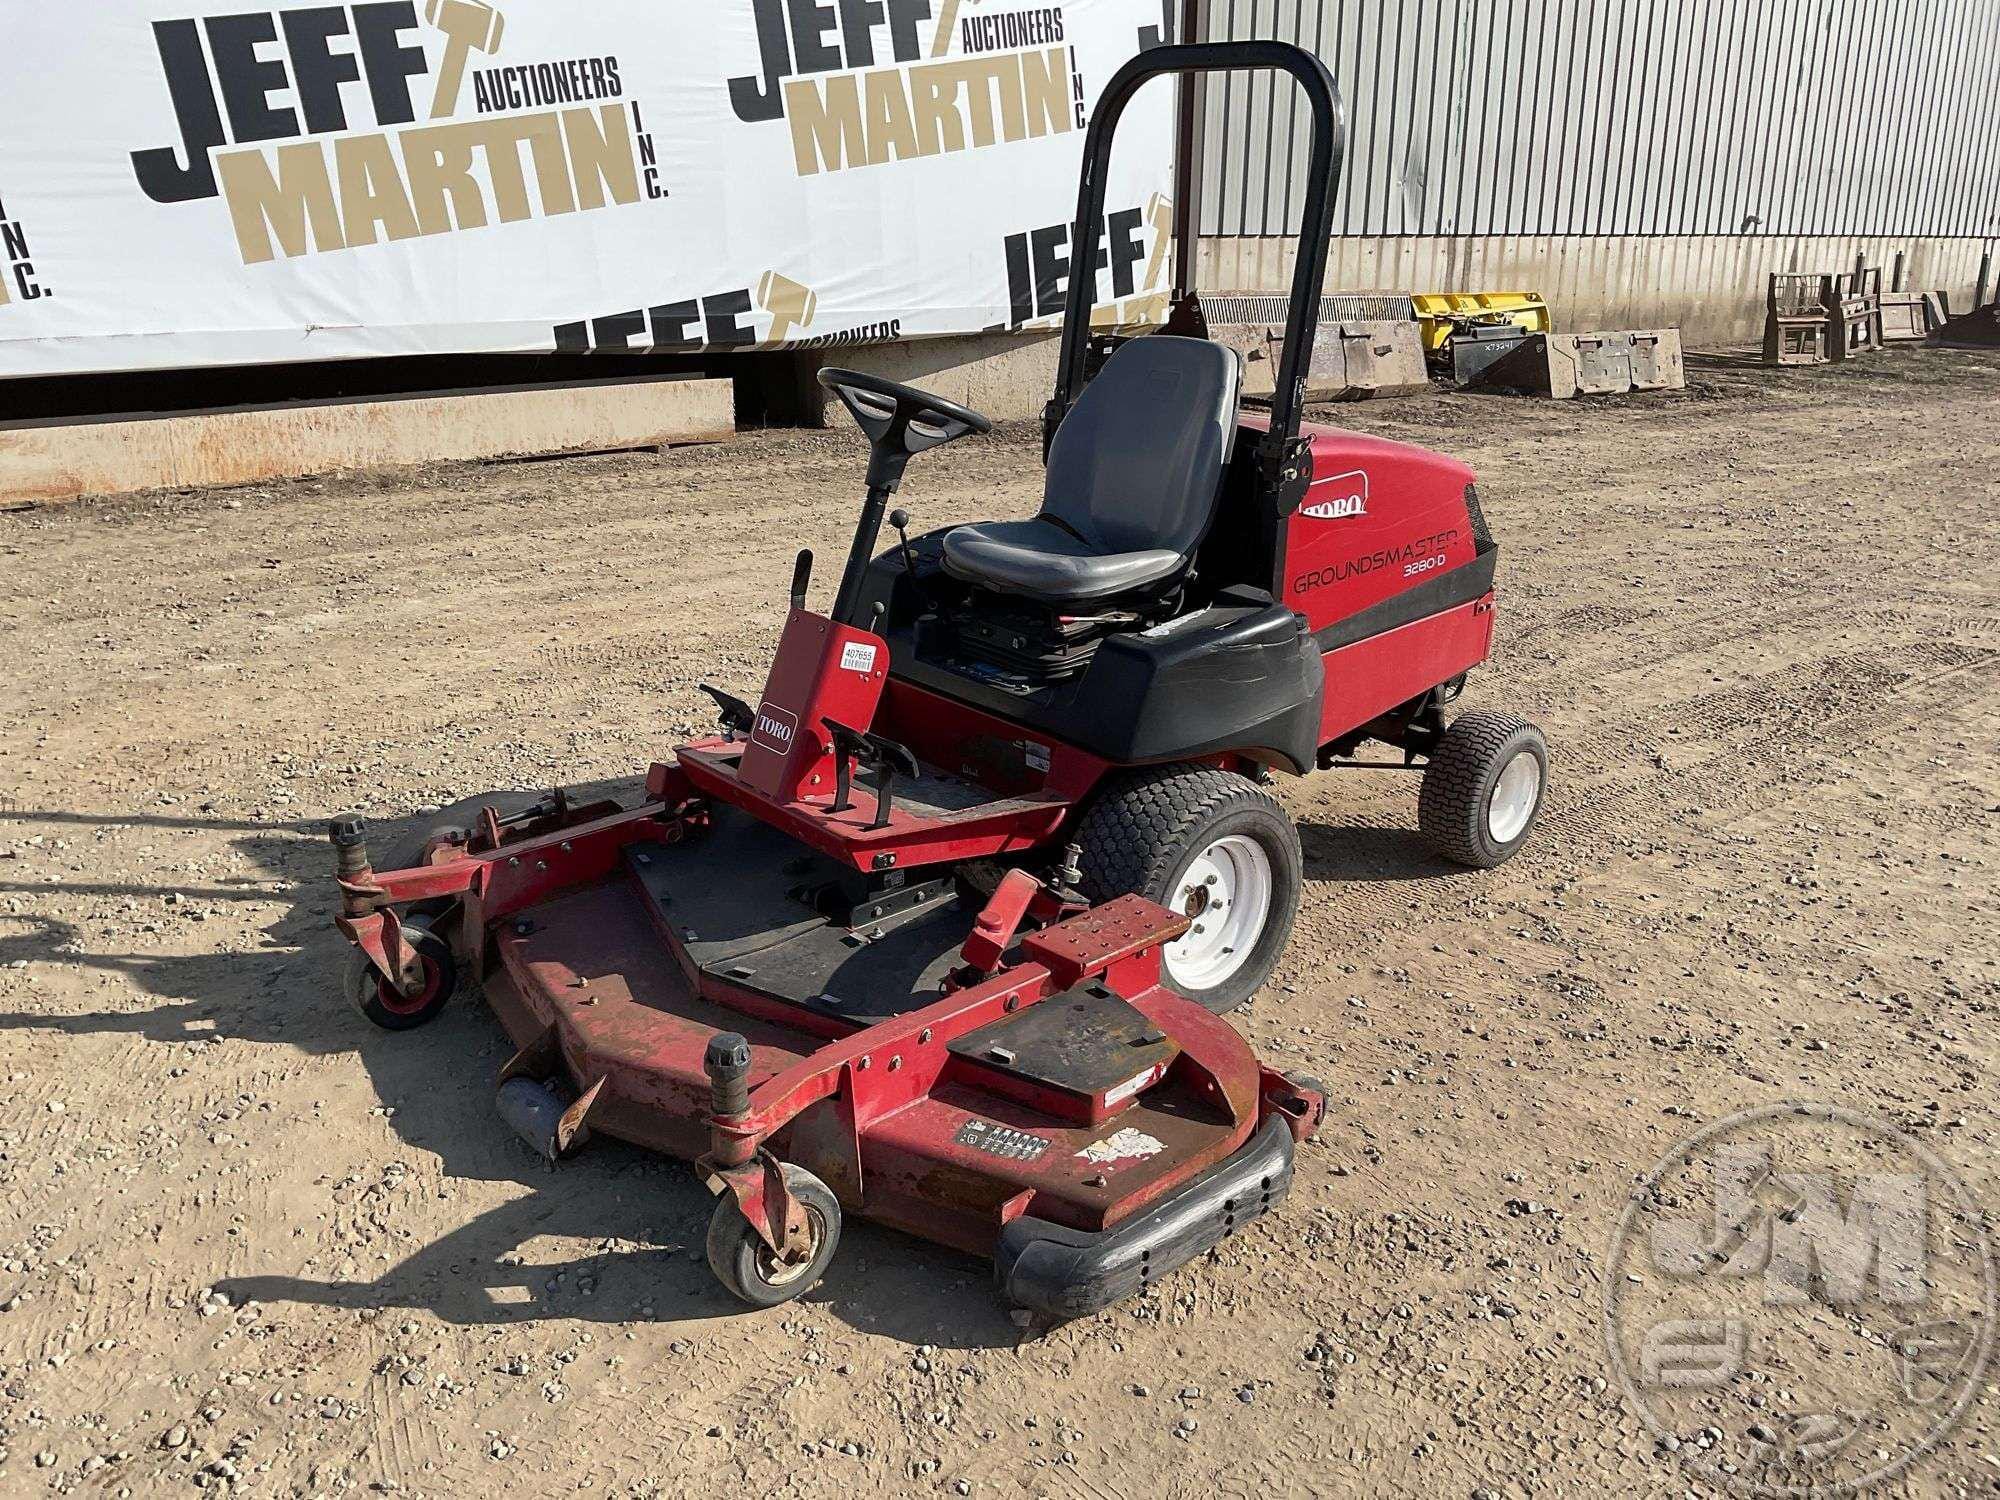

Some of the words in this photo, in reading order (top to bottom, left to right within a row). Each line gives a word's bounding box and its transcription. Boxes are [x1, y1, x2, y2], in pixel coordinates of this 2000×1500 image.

[962, 8, 1064, 54] AUCTIONEERS
[130, 0, 428, 203] JEFF
[473, 56, 622, 113] AUCTIONEERS
[784, 47, 1072, 176] MARTIN
[216, 103, 641, 265] MARTIN
[846, 648, 872, 662] 407655
[758, 715, 791, 741] TORO
